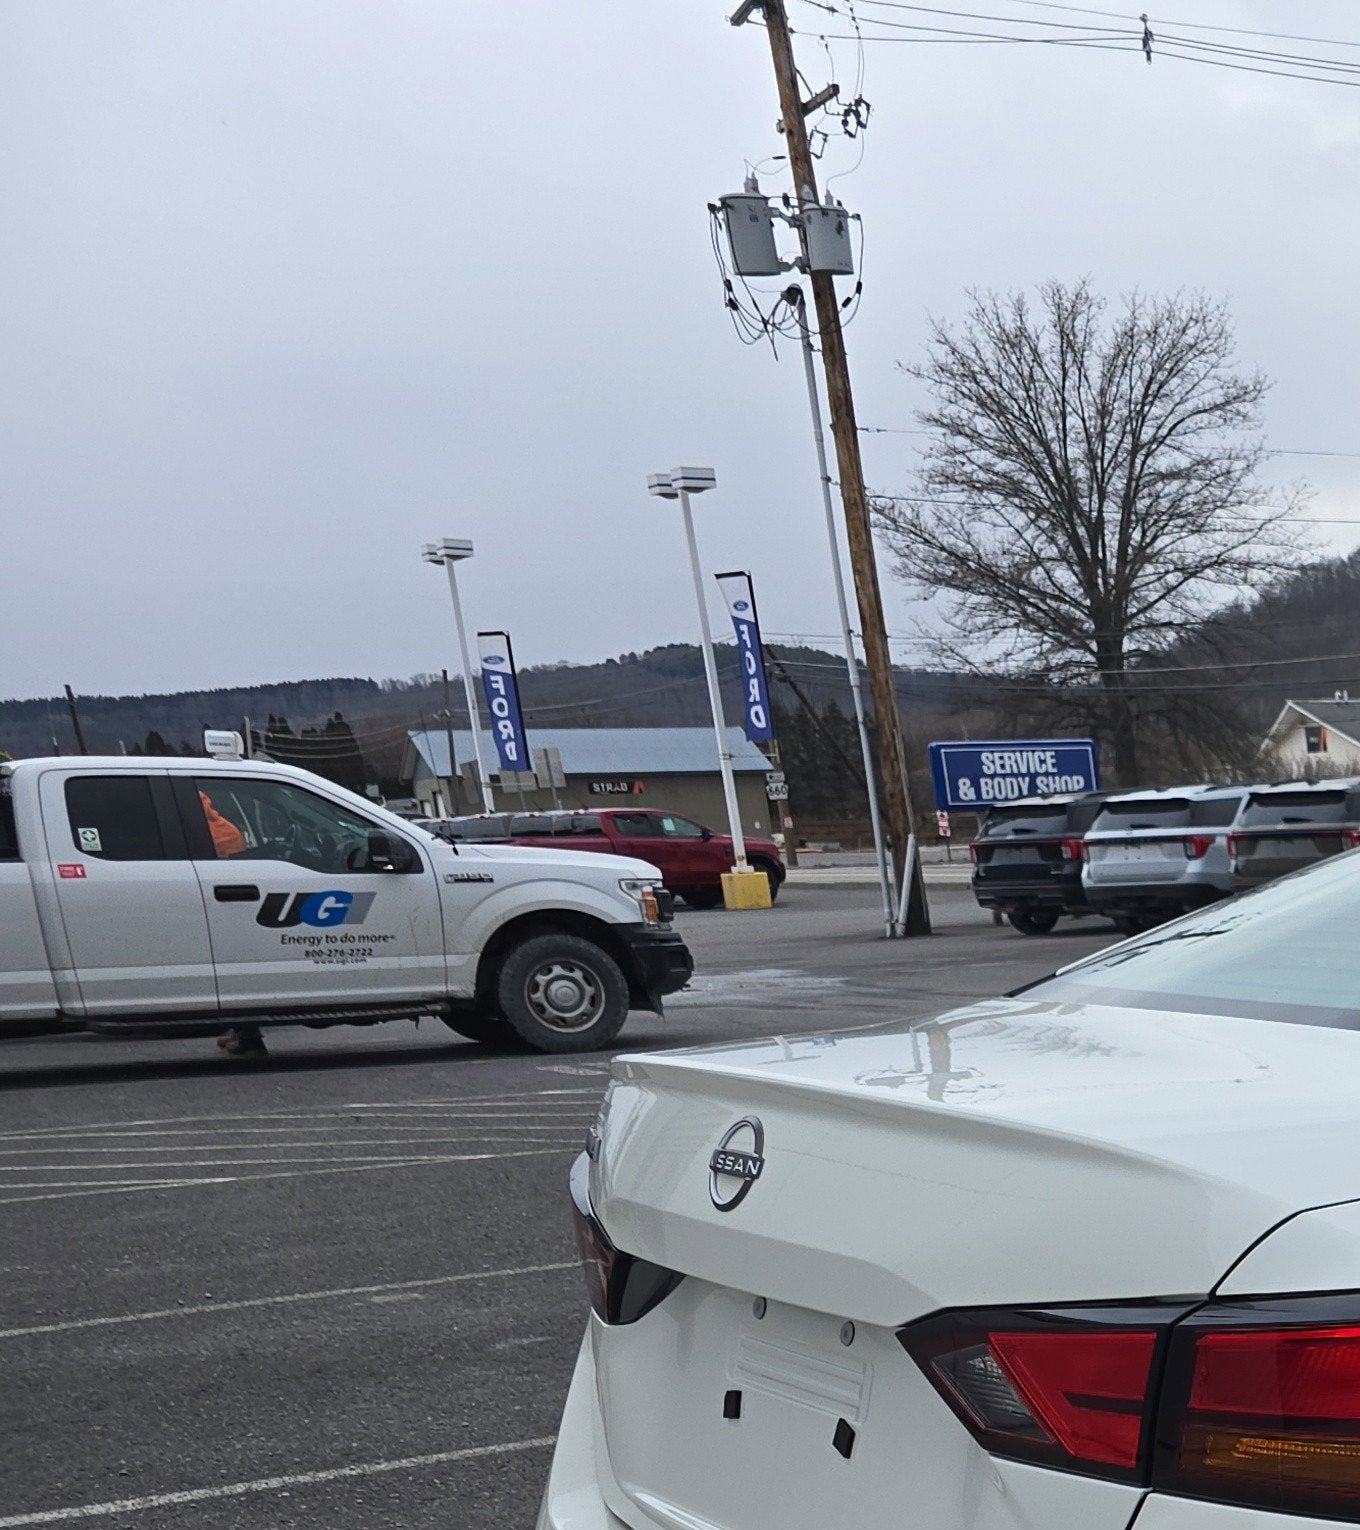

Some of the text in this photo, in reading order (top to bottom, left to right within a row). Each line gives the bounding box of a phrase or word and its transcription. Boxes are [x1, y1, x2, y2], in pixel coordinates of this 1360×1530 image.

[981, 751, 1058, 775] SERVICE
[592, 782, 628, 793] STRAD
[957, 775, 1085, 800] & BODY SHOP
[256, 890, 377, 928] UGI
[280, 933, 323, 946] Energy
[325, 934, 338, 944] to
[340, 932, 356, 943] do
[304, 948, 373, 958] 800-276-2722
[716, 1154, 760, 1175] SSAN
